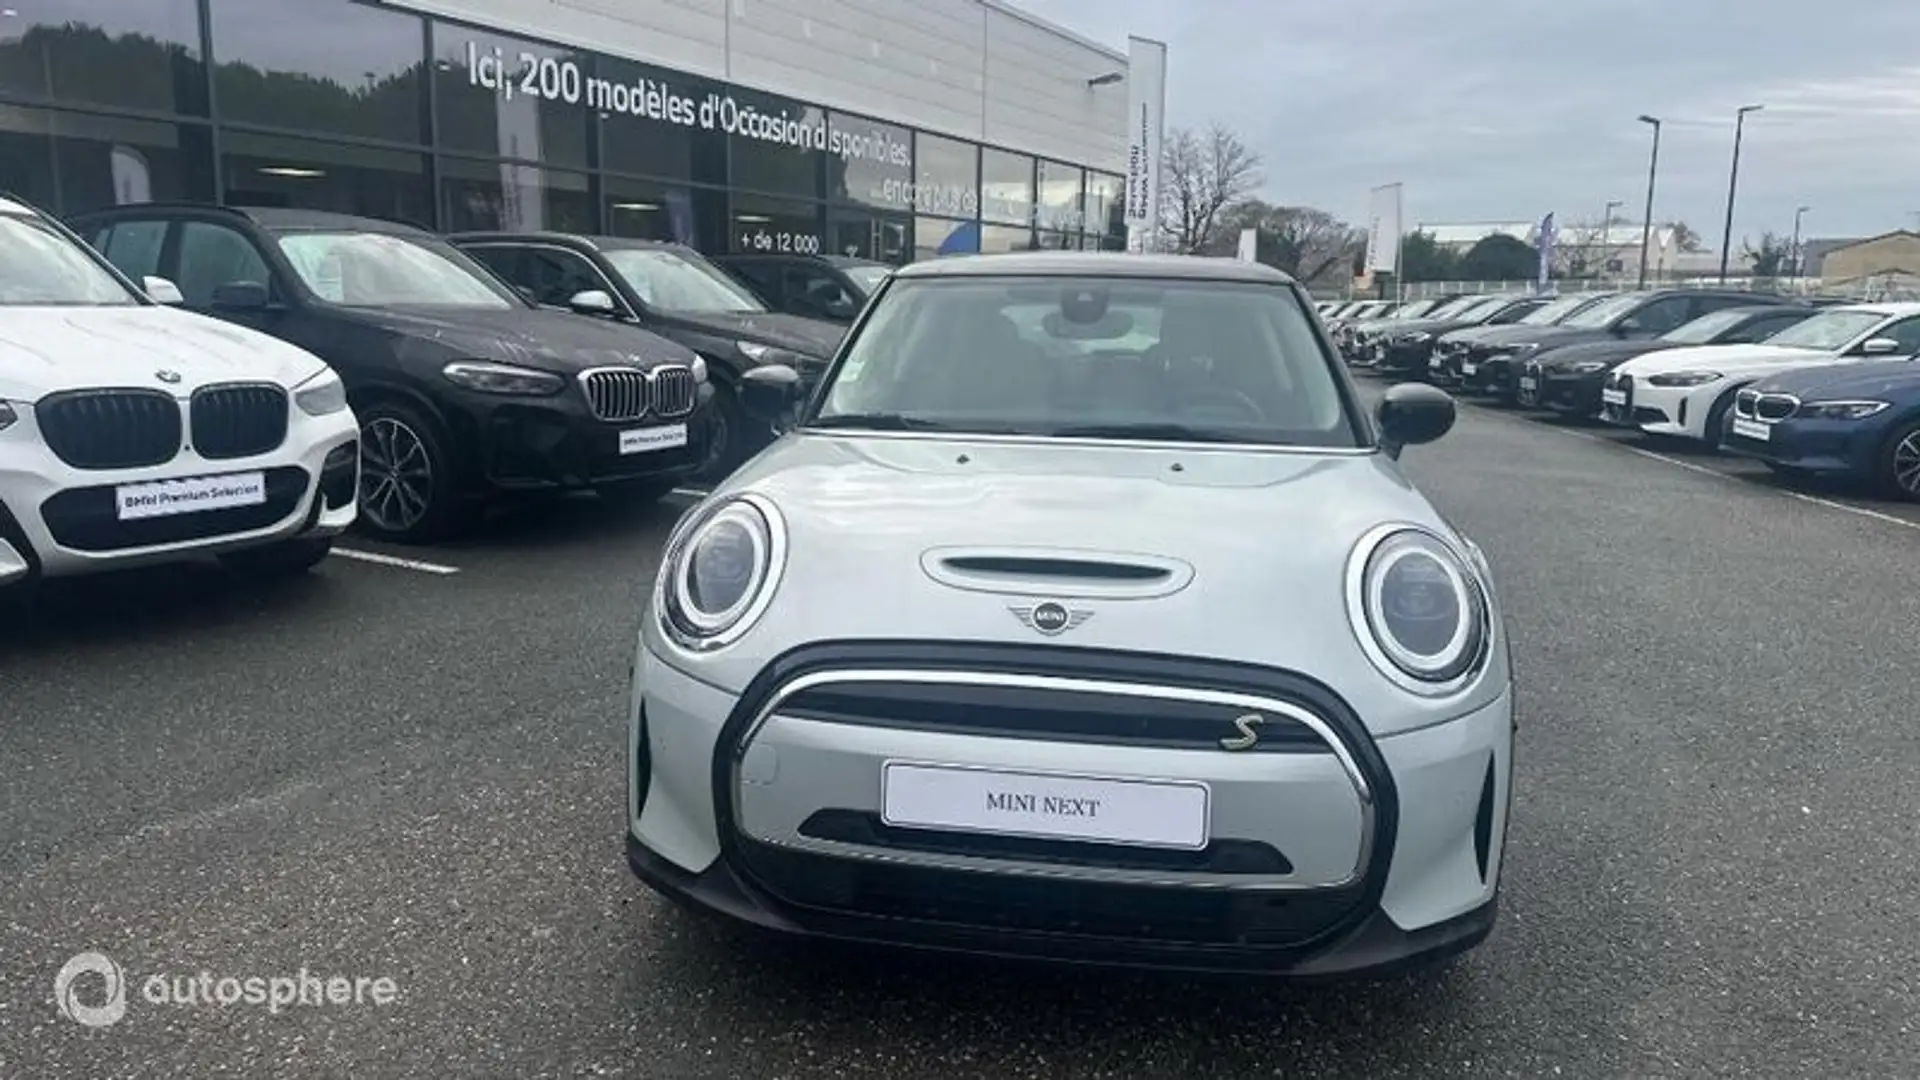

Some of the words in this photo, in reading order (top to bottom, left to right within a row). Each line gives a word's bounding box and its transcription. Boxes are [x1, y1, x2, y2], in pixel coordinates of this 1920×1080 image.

[468, 41, 512, 101] Ici,
[520, 52, 580, 104] 200
[587, 77, 695, 126] modèles
[701, 93, 811, 149] d'Occasion
[753, 229, 772, 250] de
[777, 232, 791, 251] 12
[794, 234, 819, 254] 000
[1036, 611, 1064, 621] MINI
[1220, 714, 1264, 750] S
[986, 793, 1035, 812] MINI
[1044, 796, 1100, 816] NEXT
